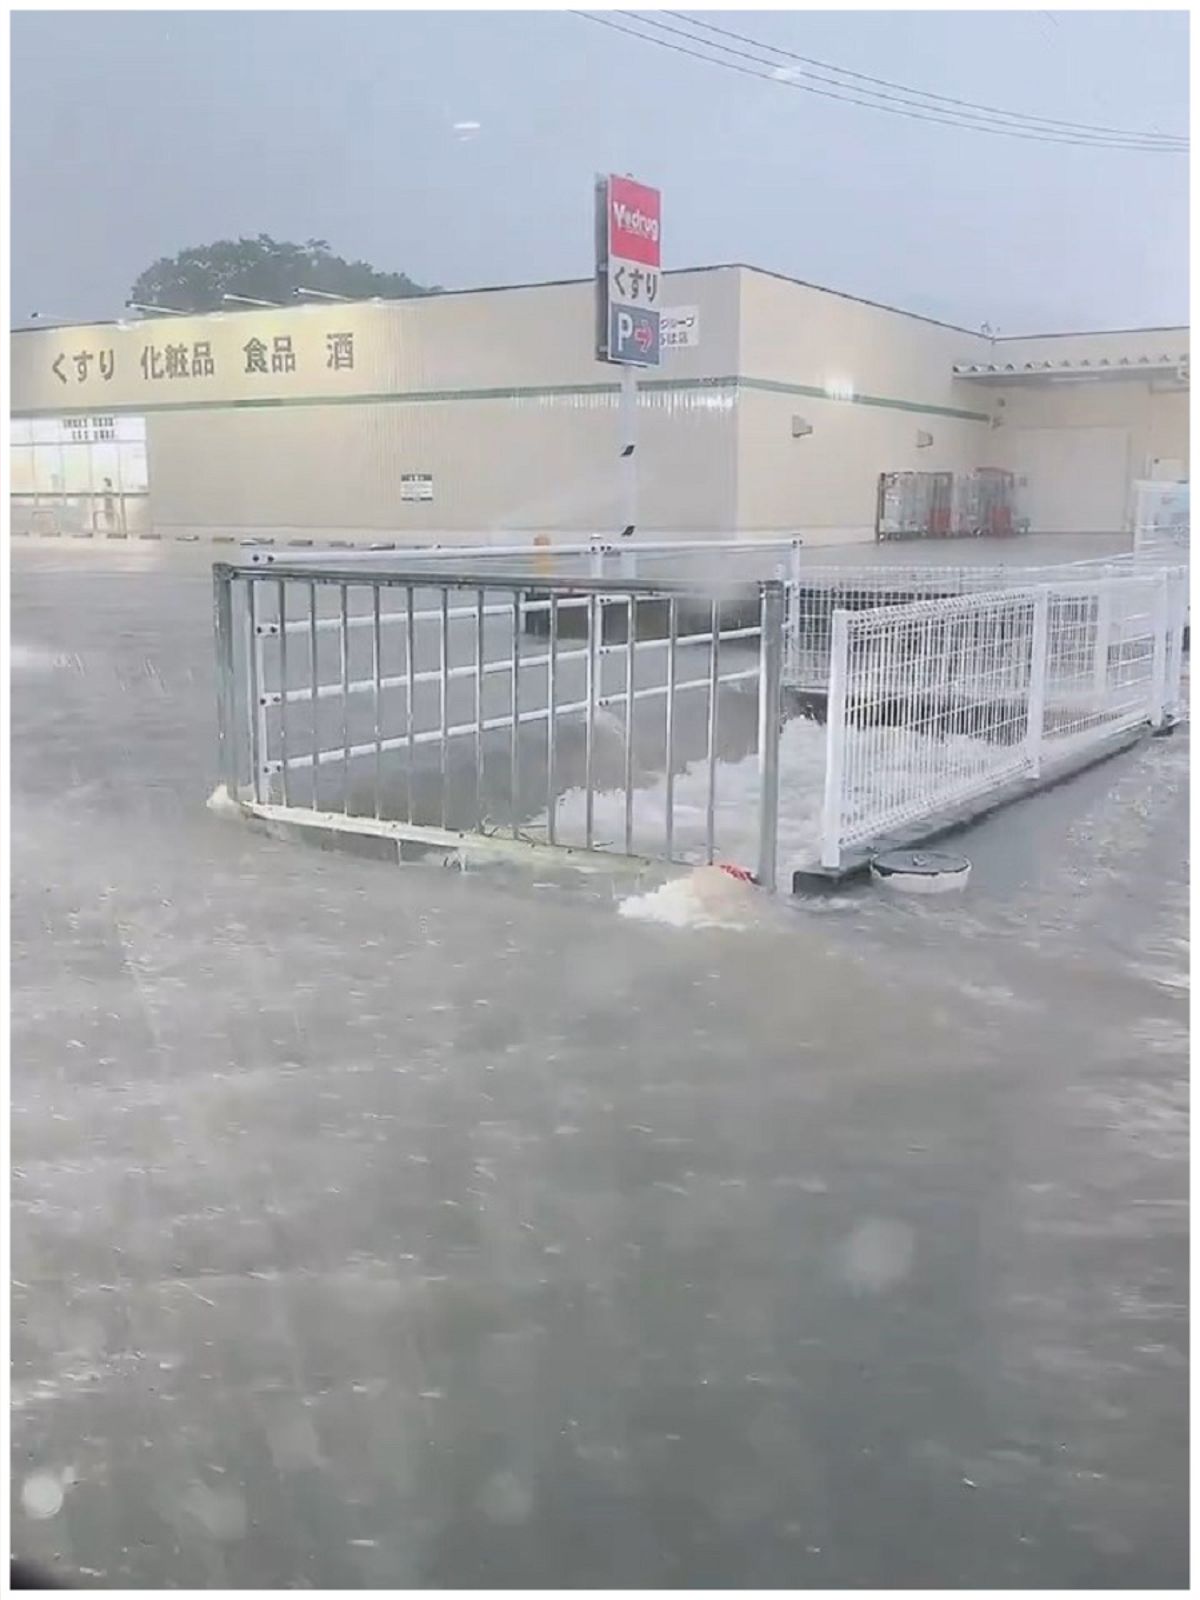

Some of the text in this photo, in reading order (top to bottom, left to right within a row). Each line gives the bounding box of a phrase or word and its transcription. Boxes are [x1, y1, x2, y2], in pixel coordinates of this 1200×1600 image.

[614, 266, 657, 302] くすり
[618, 312, 632, 351] P
[52, 332, 355, 384] くすり 化粧品 食品 酒
